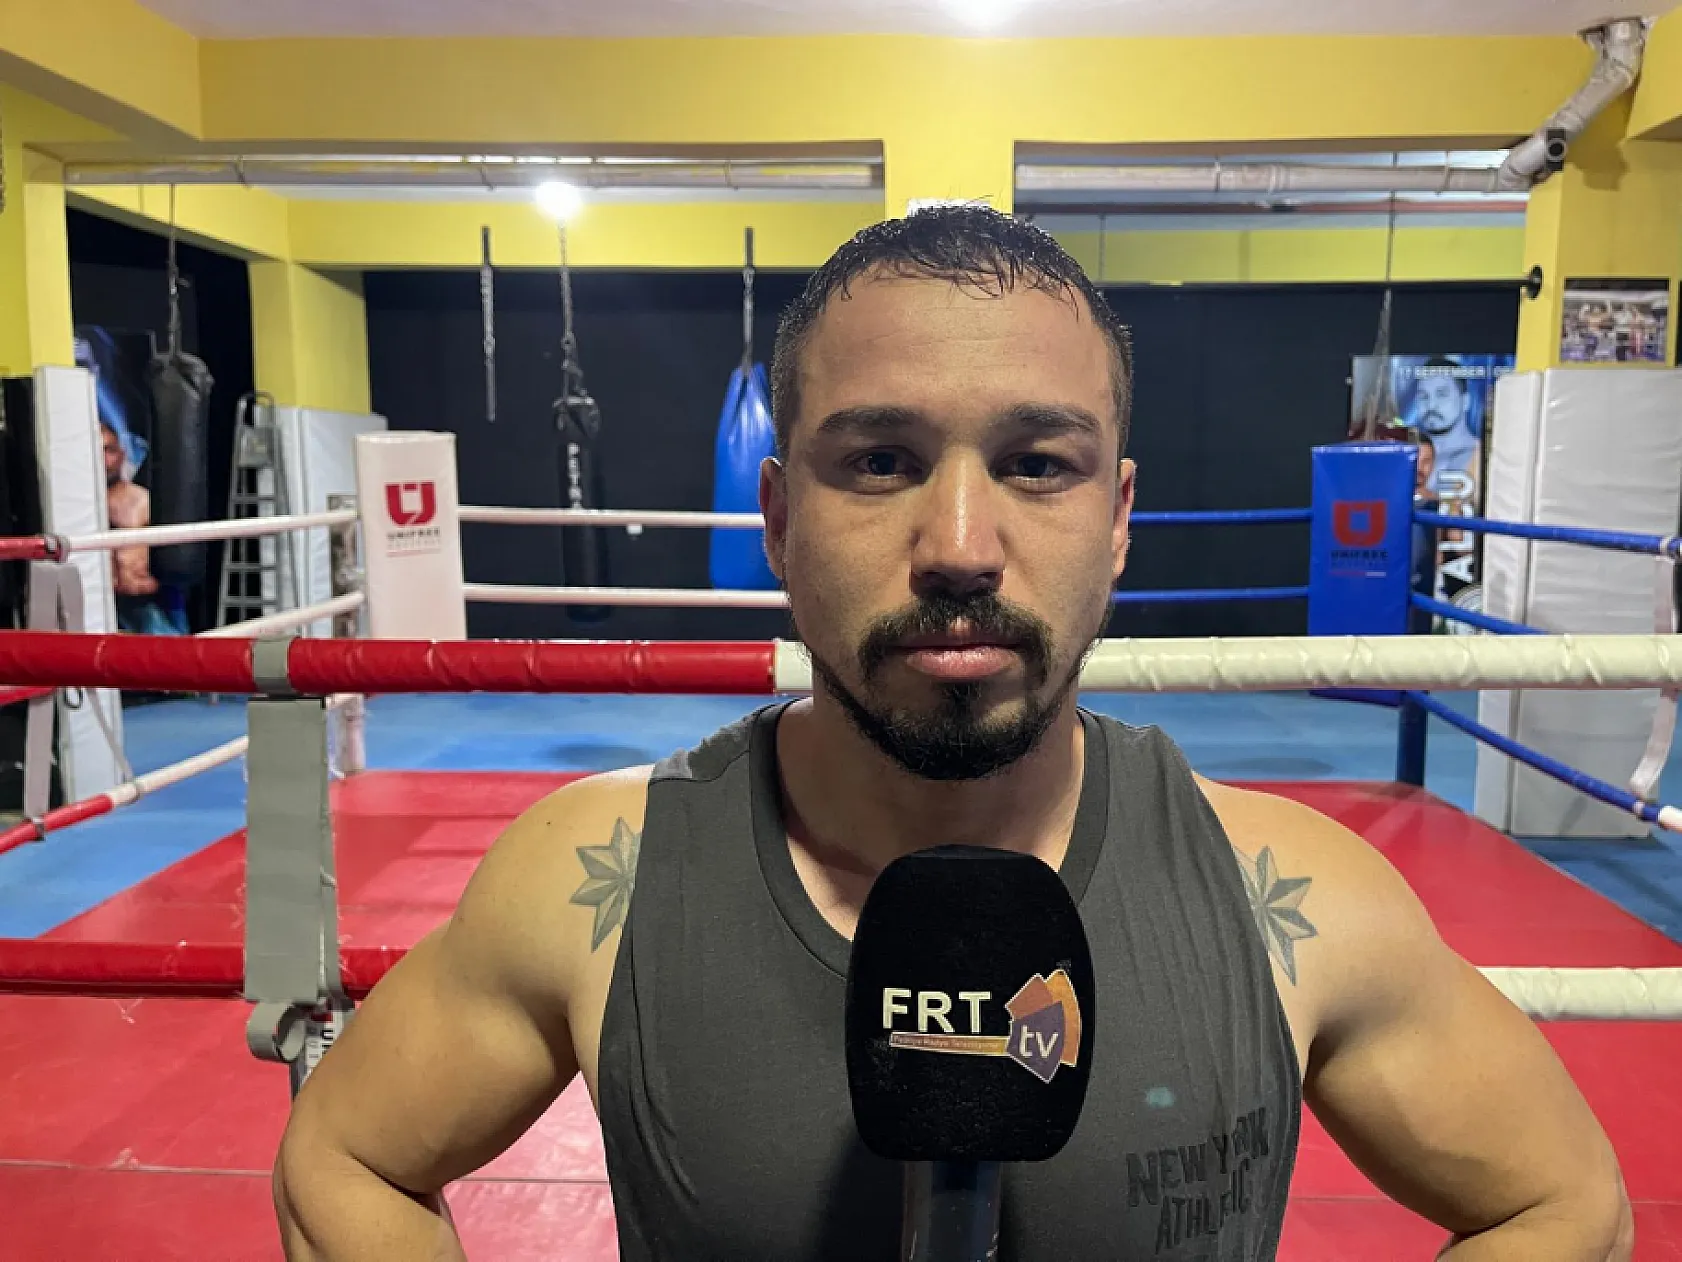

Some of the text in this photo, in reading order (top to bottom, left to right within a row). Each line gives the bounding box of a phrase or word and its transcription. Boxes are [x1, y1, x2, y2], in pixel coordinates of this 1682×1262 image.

[882, 987, 992, 1034] FRT
[1018, 1024, 1059, 1058] tv
[1126, 1143, 1207, 1207] NEW
